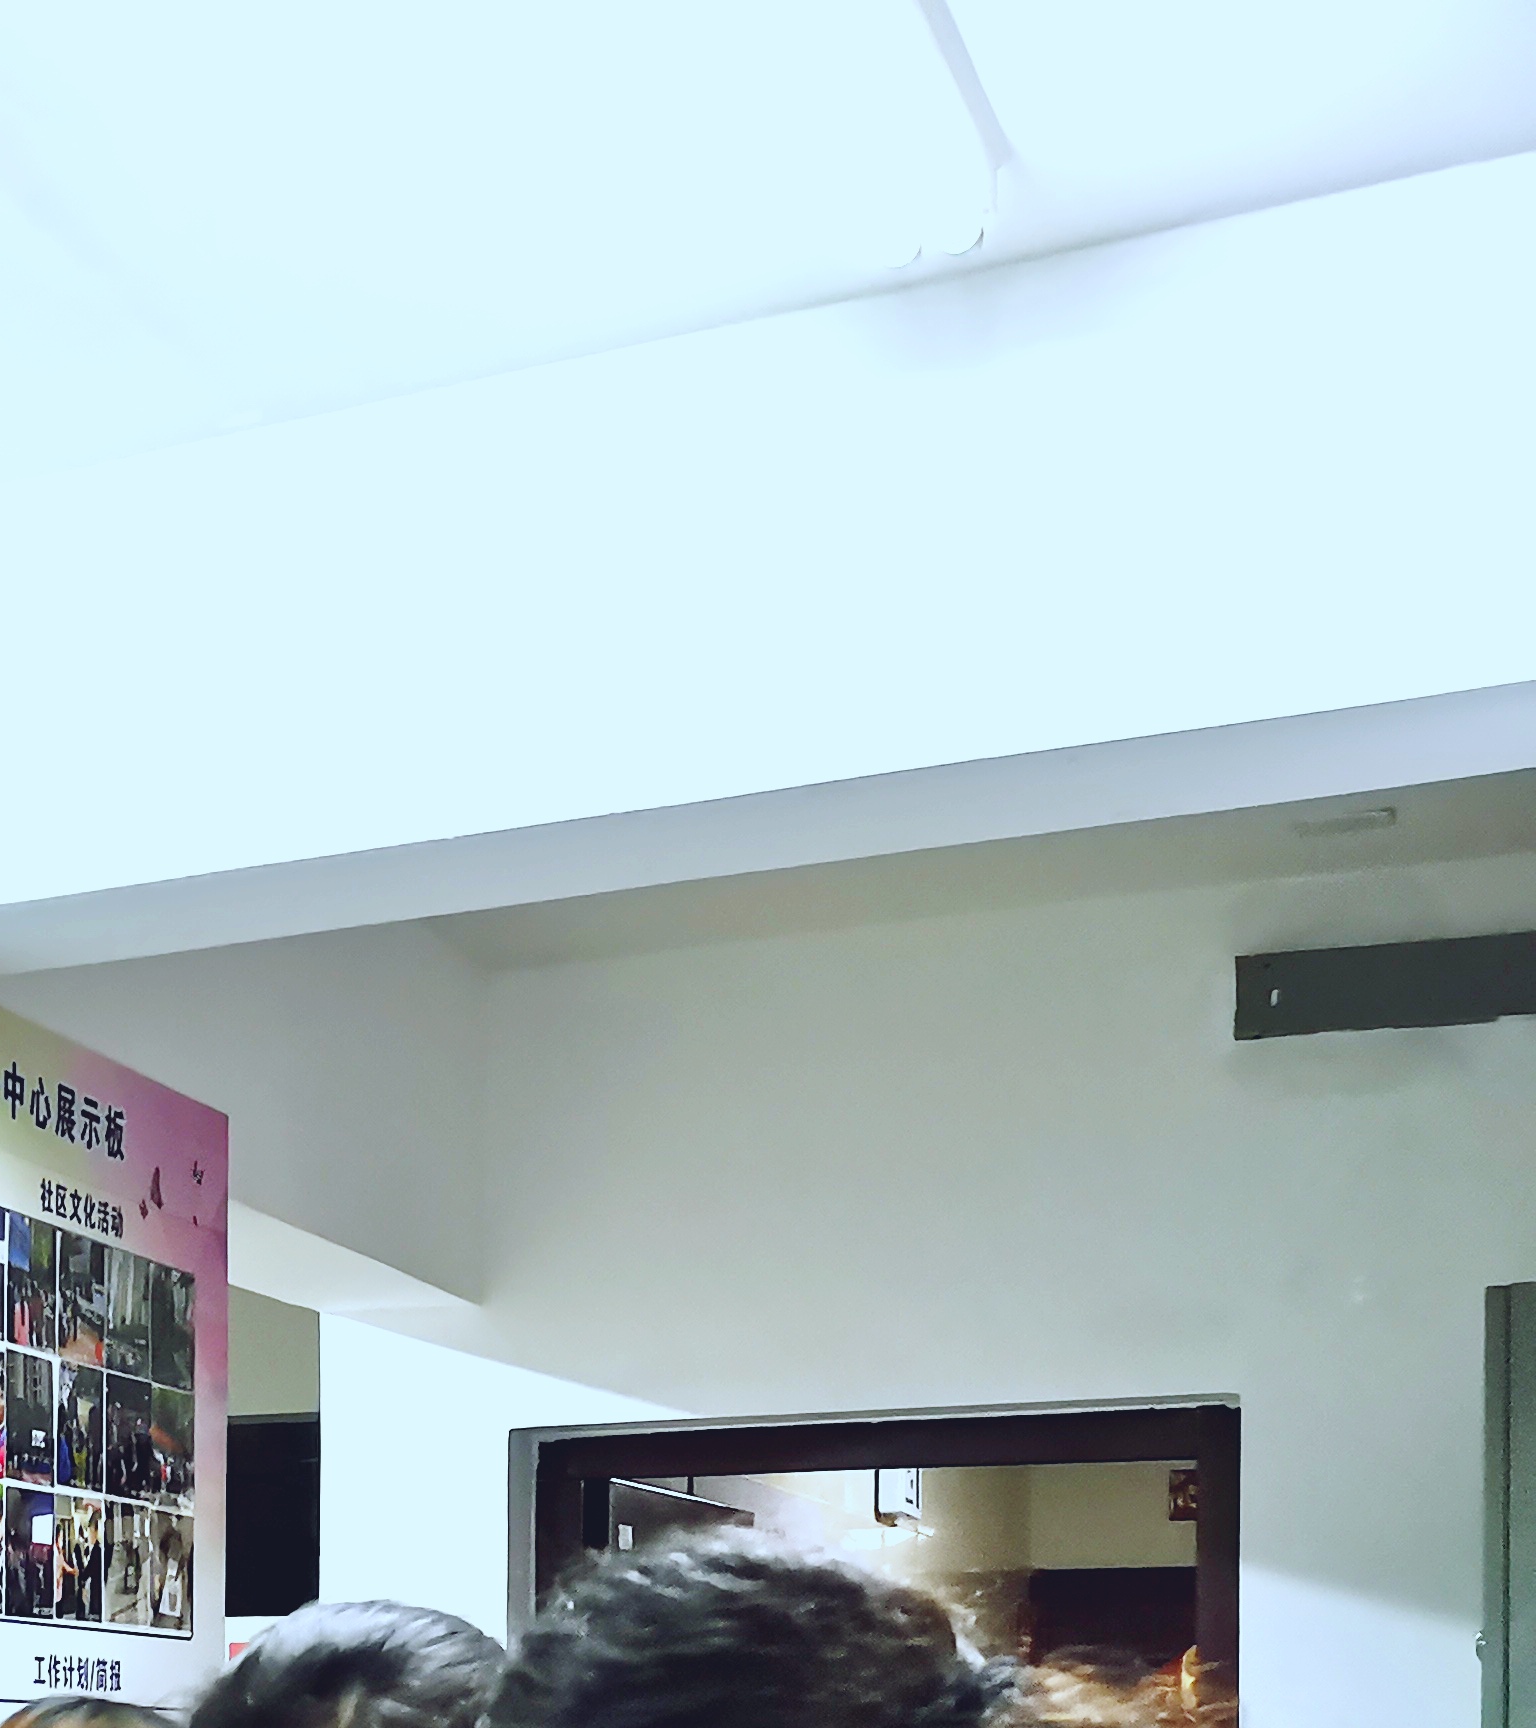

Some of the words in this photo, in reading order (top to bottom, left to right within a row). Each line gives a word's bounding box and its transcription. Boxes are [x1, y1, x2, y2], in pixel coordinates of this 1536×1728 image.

[39, 1178, 124, 1239] 社区文化活动
[33, 1654, 122, 1692] 工作计划/简报
